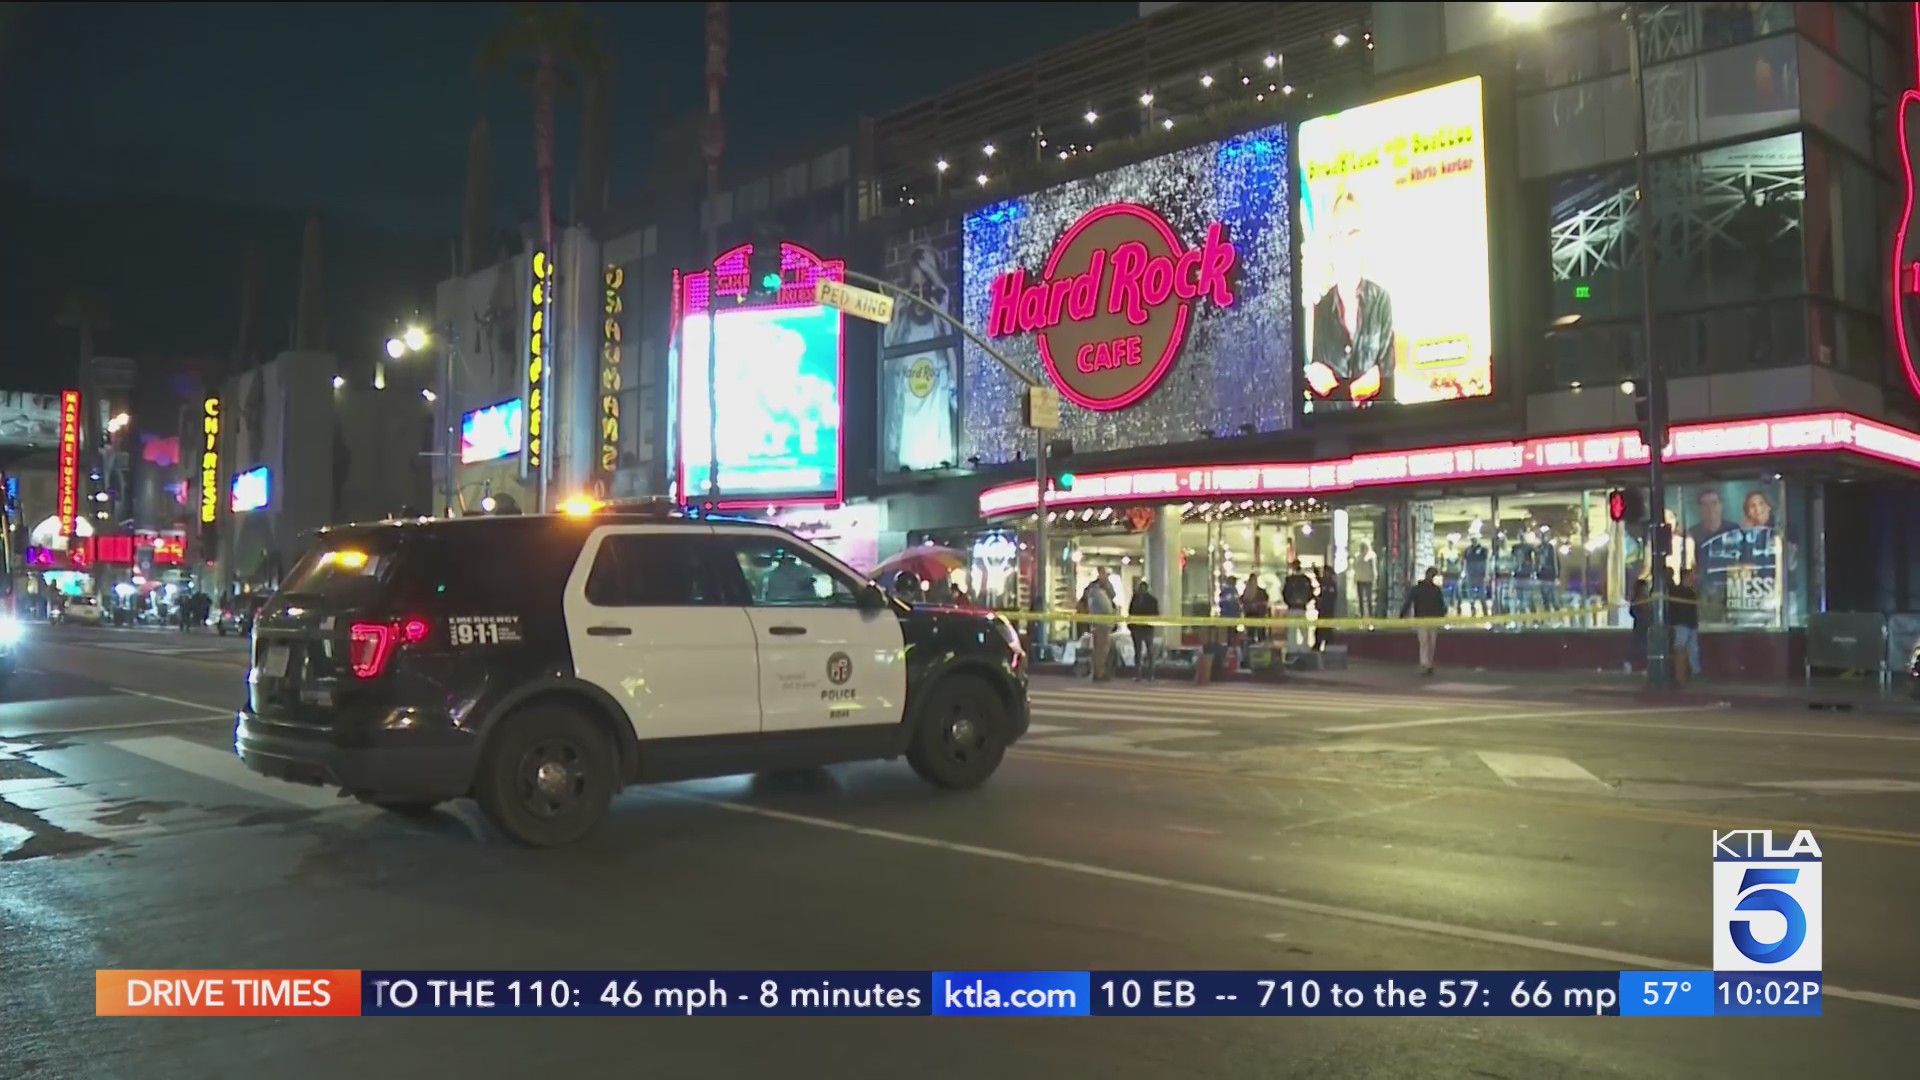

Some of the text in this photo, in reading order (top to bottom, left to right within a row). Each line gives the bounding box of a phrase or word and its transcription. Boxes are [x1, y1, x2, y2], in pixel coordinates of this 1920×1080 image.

[987, 221, 1237, 338] Hard Rock
[820, 285, 850, 308] PED
[854, 295, 888, 318] XING
[1076, 335, 1143, 374] CAFE
[62, 393, 77, 535] MADAME TUSSAUDS
[201, 397, 220, 523] CHINESE
[448, 616, 519, 624] EMERGENCY
[820, 688, 857, 702] POLICE
